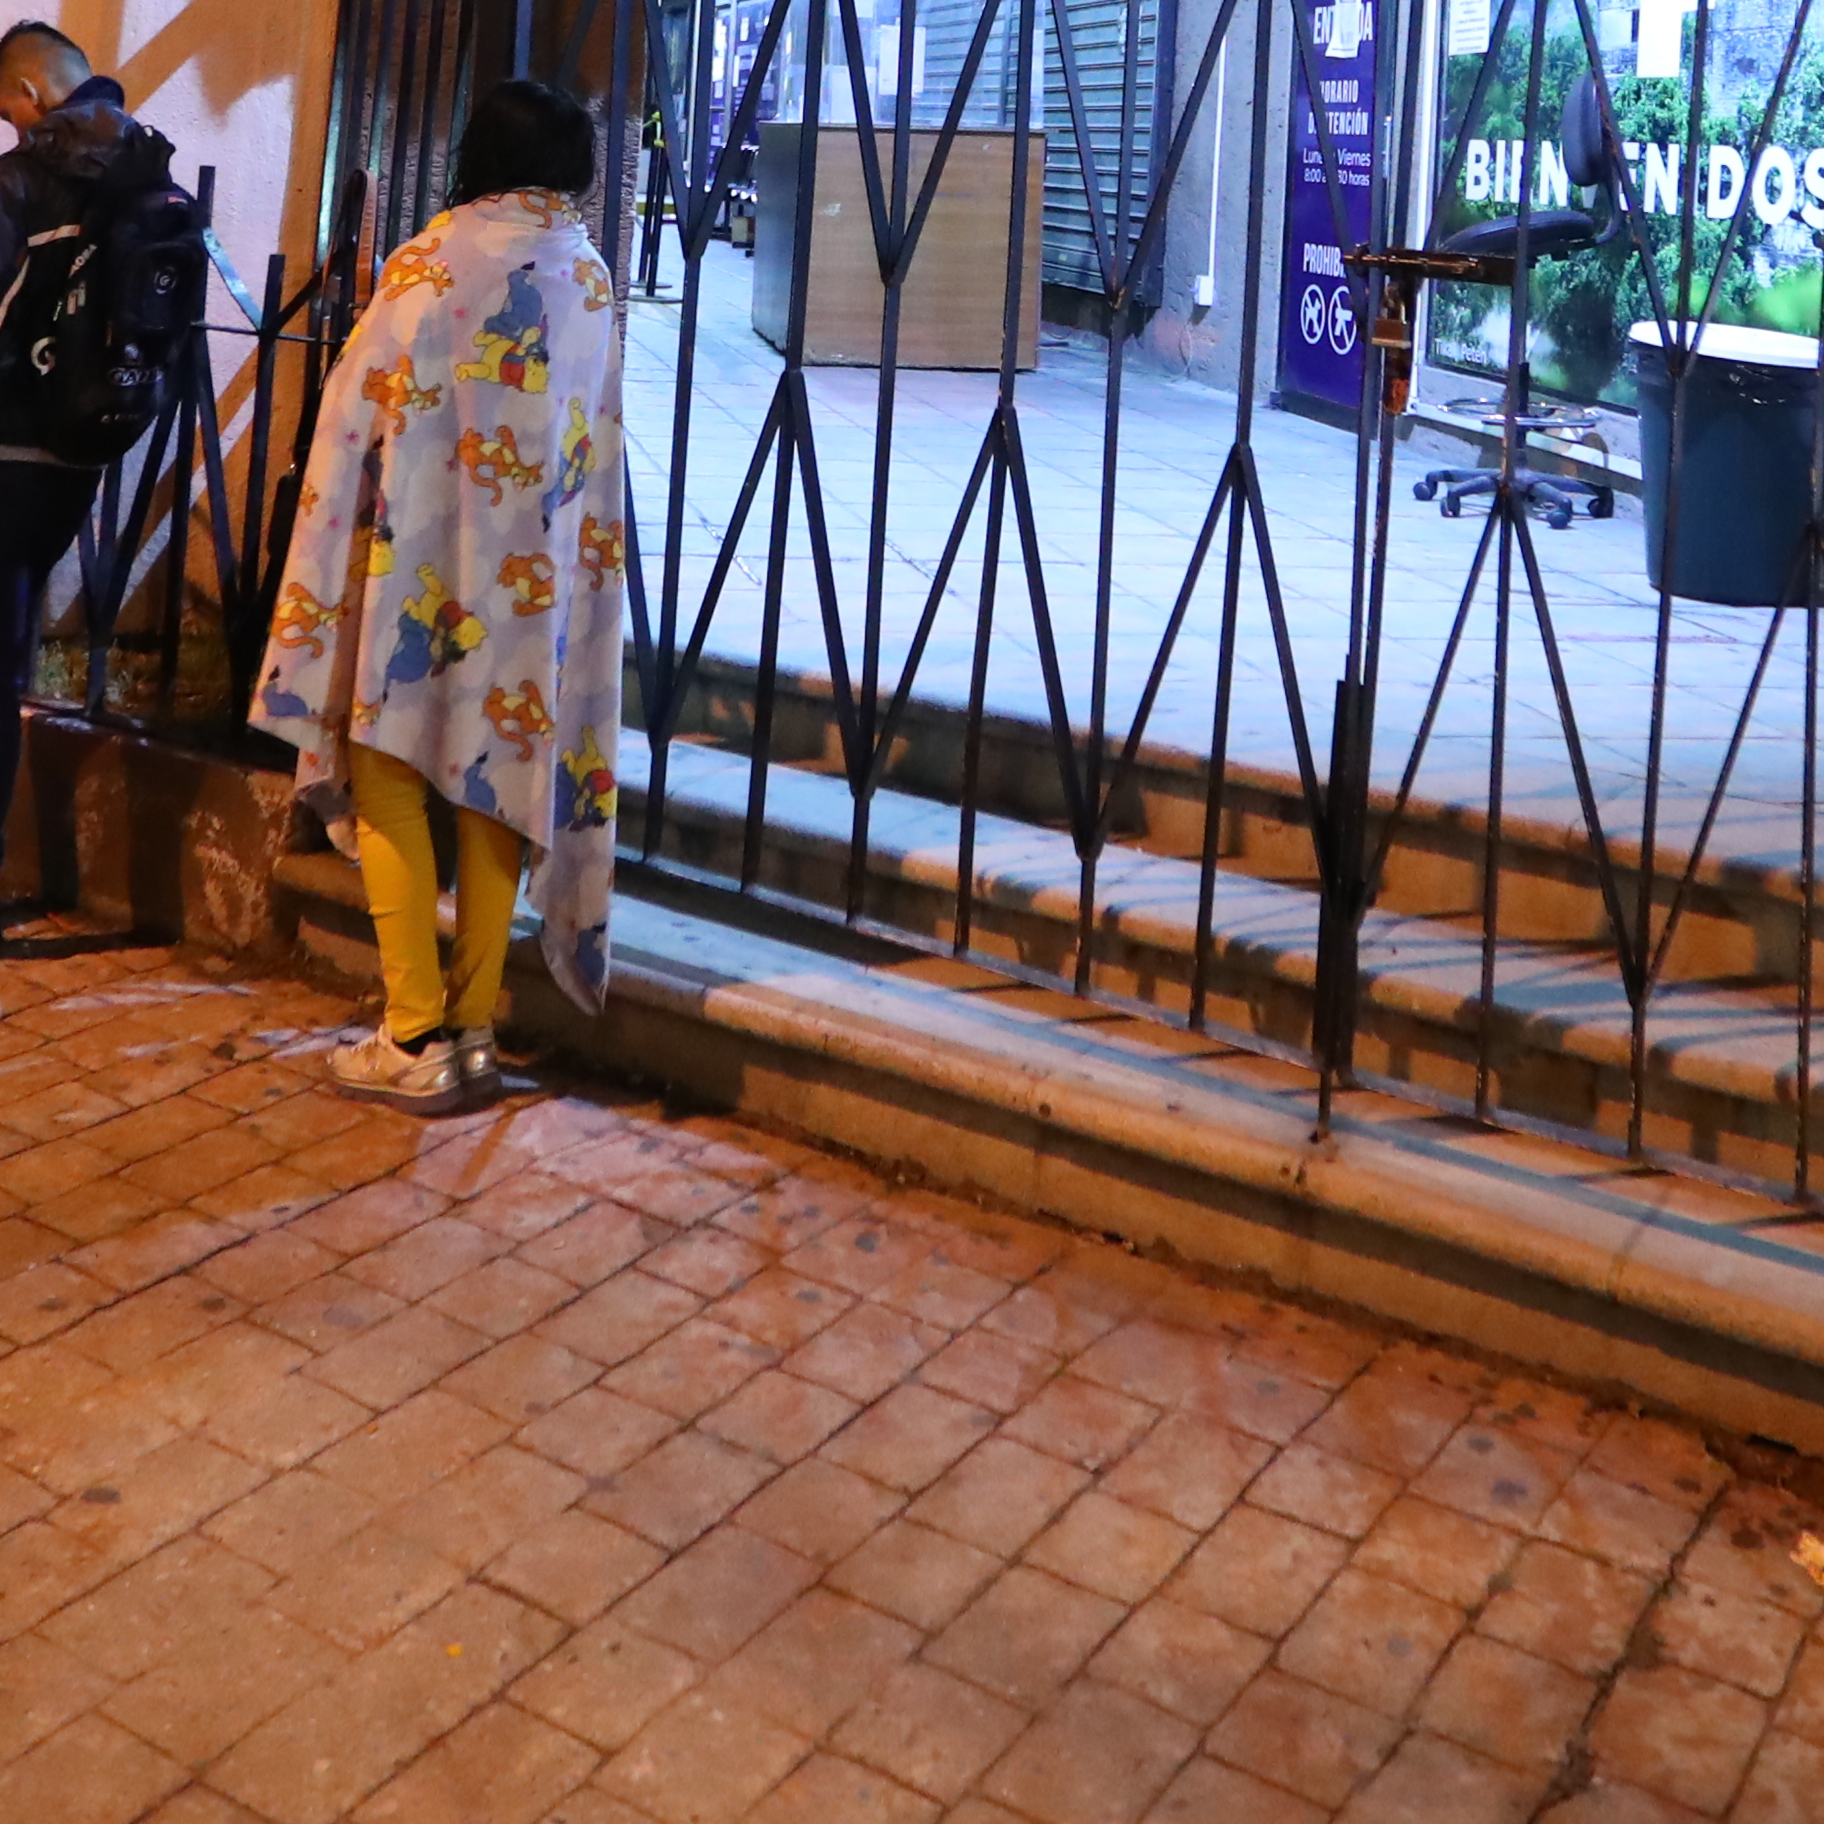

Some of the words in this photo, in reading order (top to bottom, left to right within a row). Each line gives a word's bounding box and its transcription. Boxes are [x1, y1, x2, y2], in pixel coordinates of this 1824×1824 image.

[1325, 107, 1369, 136] TENCIÓN
[1337, 147, 1371, 168] Viernes
[1348, 172, 1370, 187] horas
